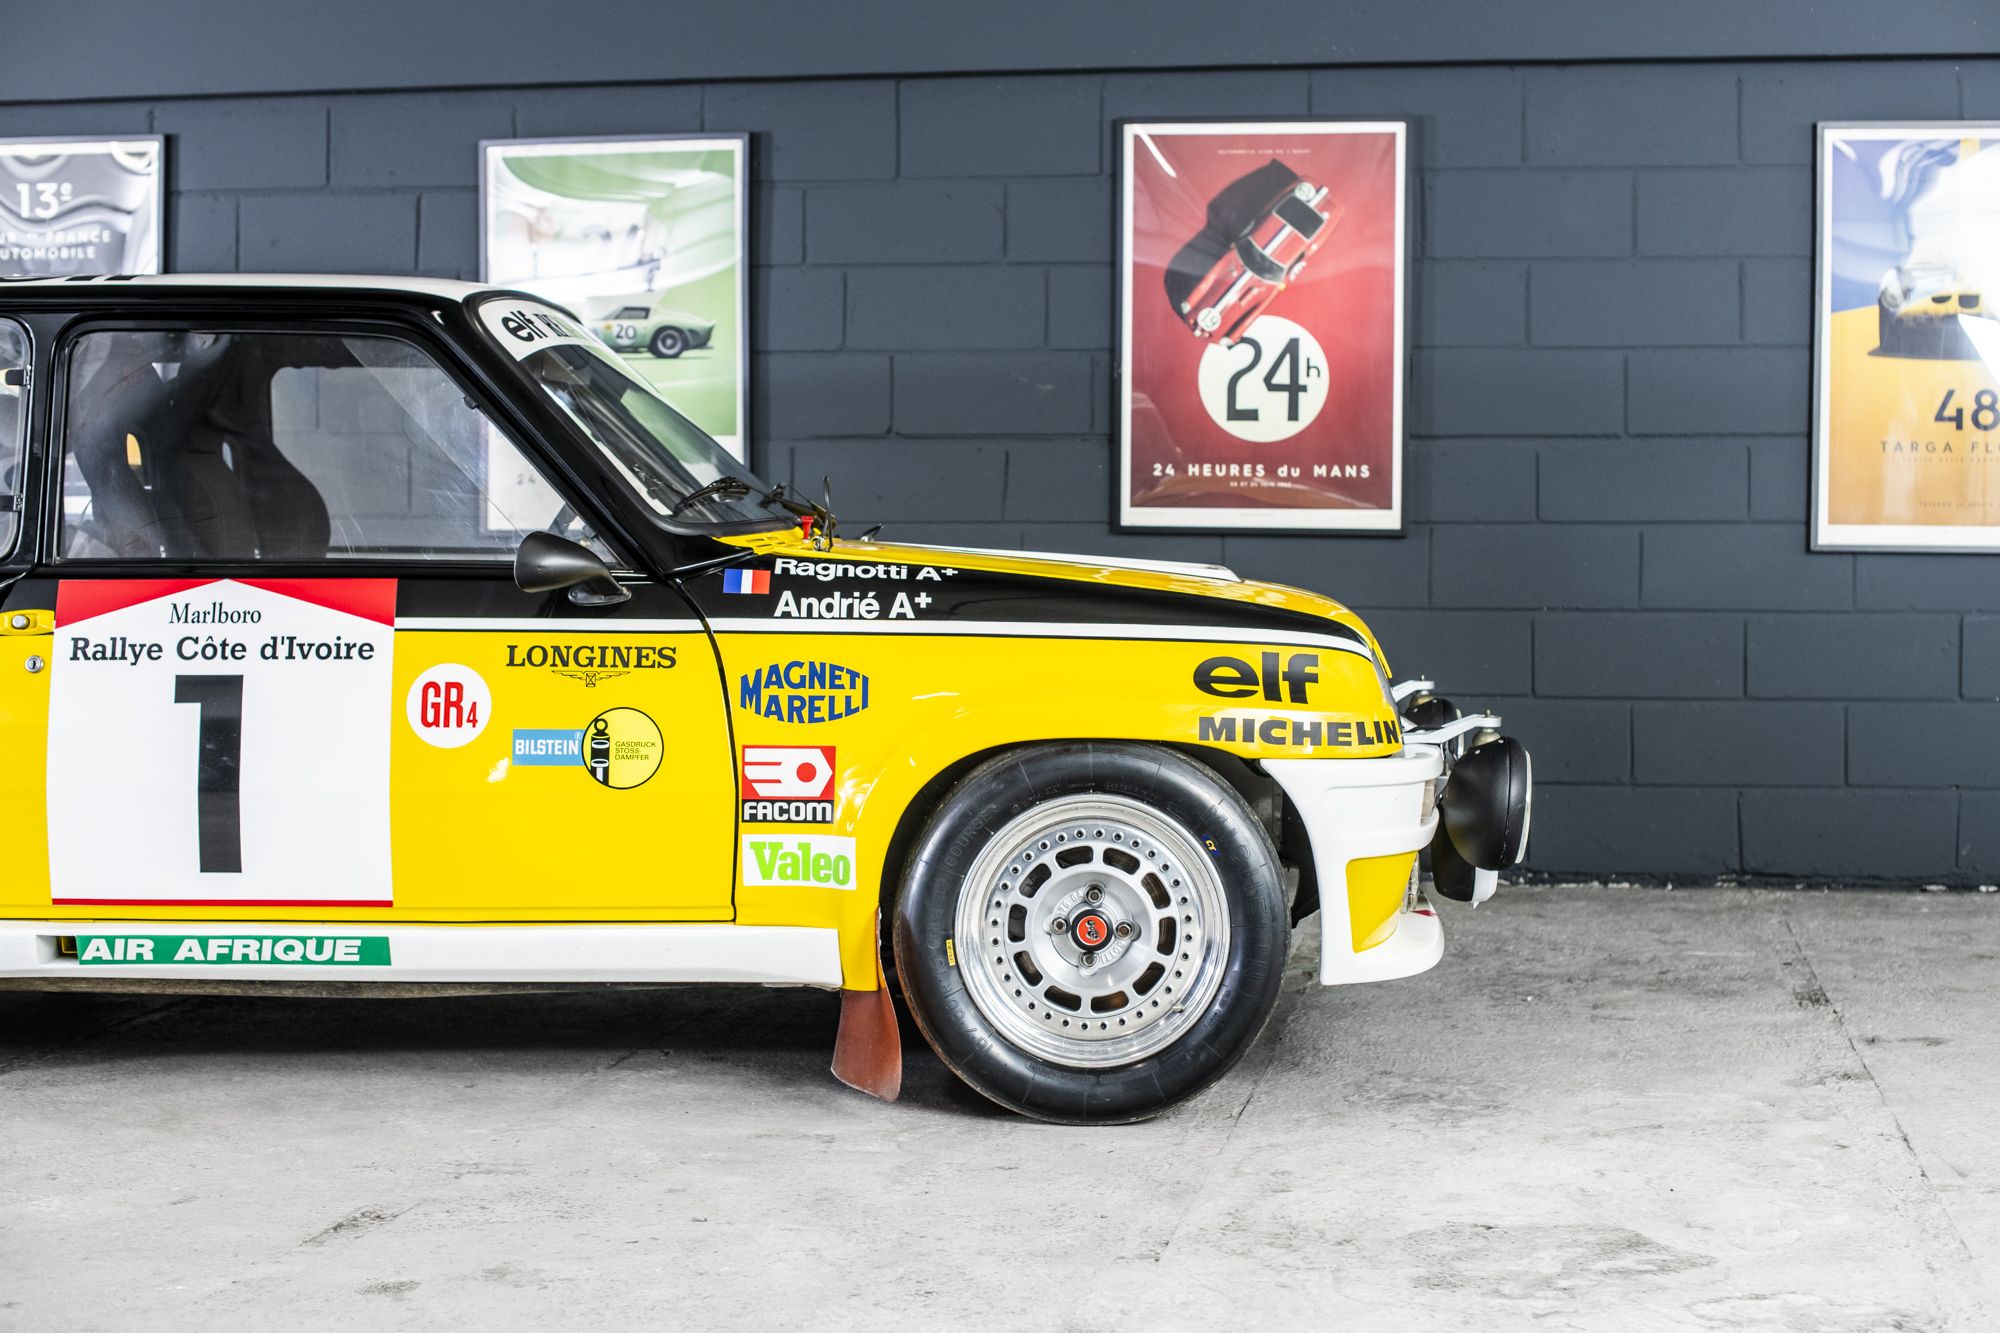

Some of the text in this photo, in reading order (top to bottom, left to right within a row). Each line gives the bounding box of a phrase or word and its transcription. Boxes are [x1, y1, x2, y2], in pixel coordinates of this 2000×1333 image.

[502, 310, 548, 342] elf
[615, 324, 638, 341] 20
[1934, 389, 2000, 431] 48
[1880, 441, 2000, 453] TARGA FL
[1152, 463, 1370, 478] 24 HEURES du MANS
[774, 557, 959, 581] Ragnotti A+
[169, 602, 262, 624] Marlboro
[773, 590, 932, 619] Andrié A+
[69, 635, 375, 665] Rallye Côte d'Ivoire
[506, 645, 677, 669] LONGINES
[741, 660, 869, 702] MAGNETI
[1193, 651, 1319, 704] elf
[741, 682, 869, 723] MARELLI
[1198, 716, 1399, 747] MICHELIN
[174, 674, 244, 873] 1
[743, 801, 832, 821] FACOM
[749, 841, 851, 886] Valeo
[81, 937, 361, 962] AIR AFRIQUE
